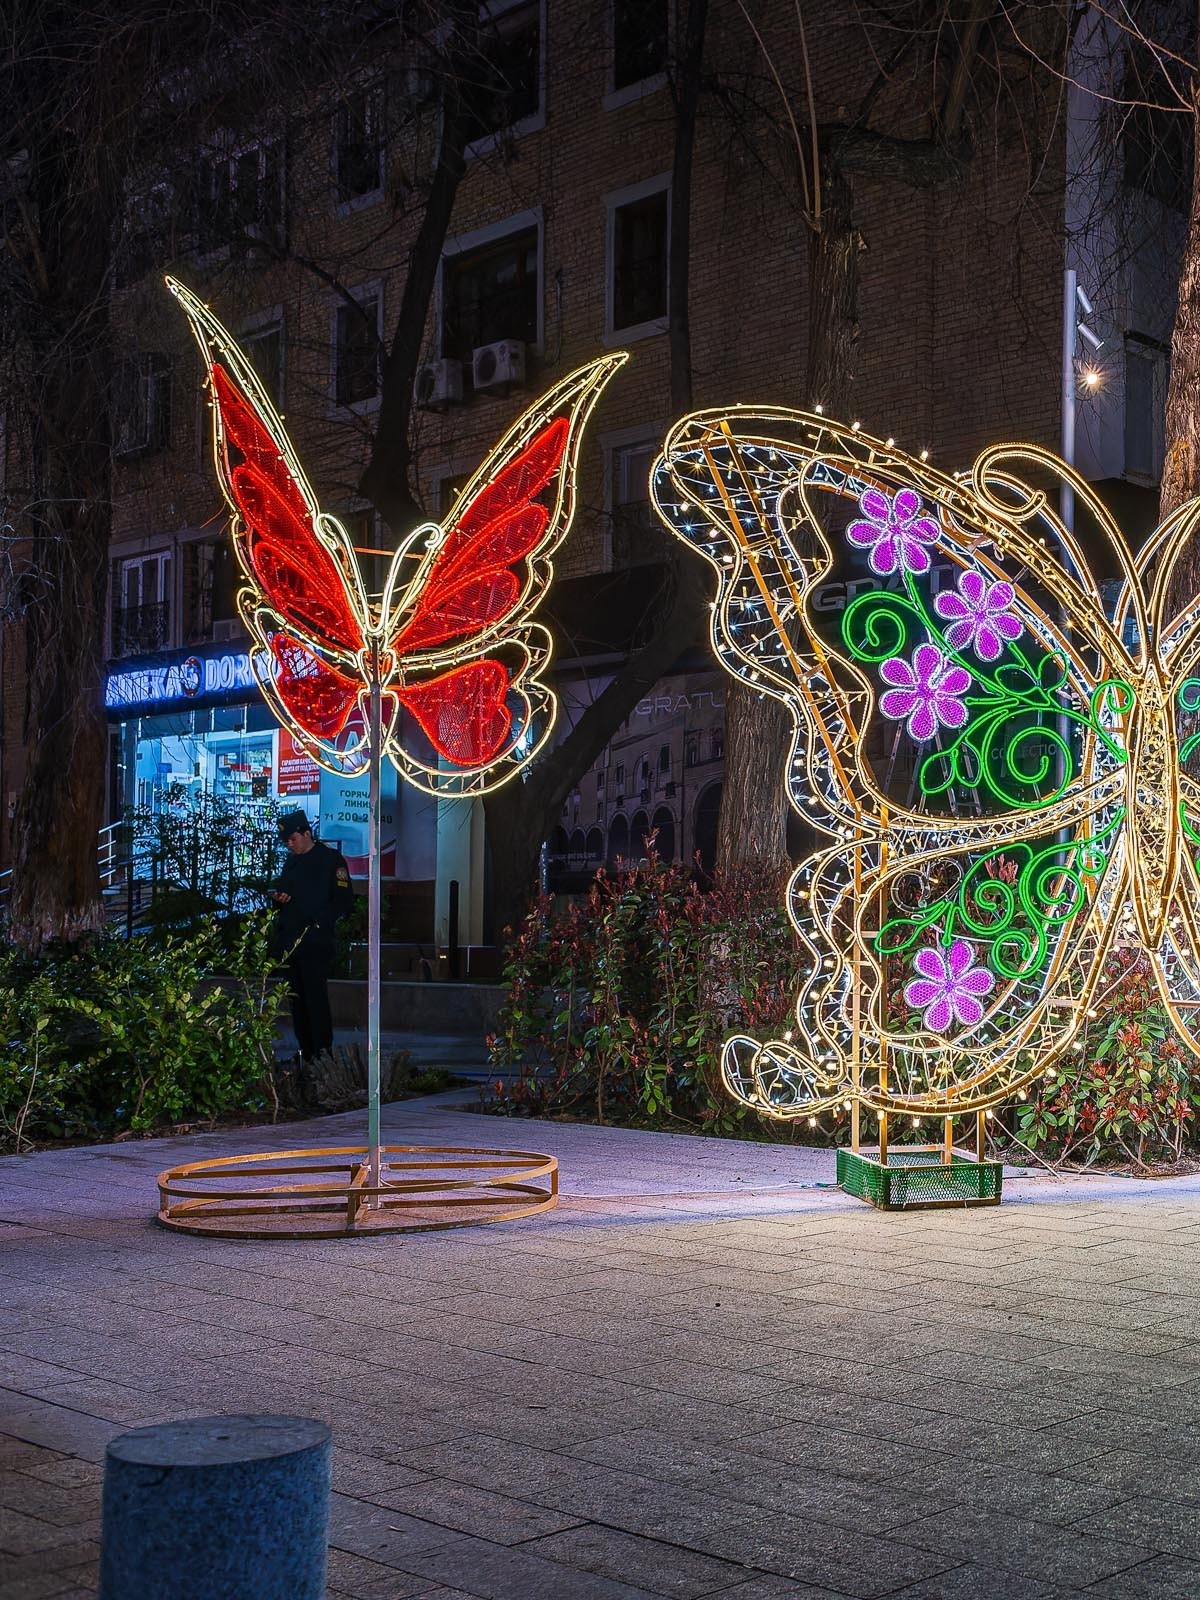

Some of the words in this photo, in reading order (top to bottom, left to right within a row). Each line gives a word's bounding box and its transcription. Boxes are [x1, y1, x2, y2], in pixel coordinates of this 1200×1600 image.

[105, 666, 182, 706] АПТЕКА
[340, 790, 370, 799] ГОРЯЧ
[344, 799, 371, 809] ЛИНИ
